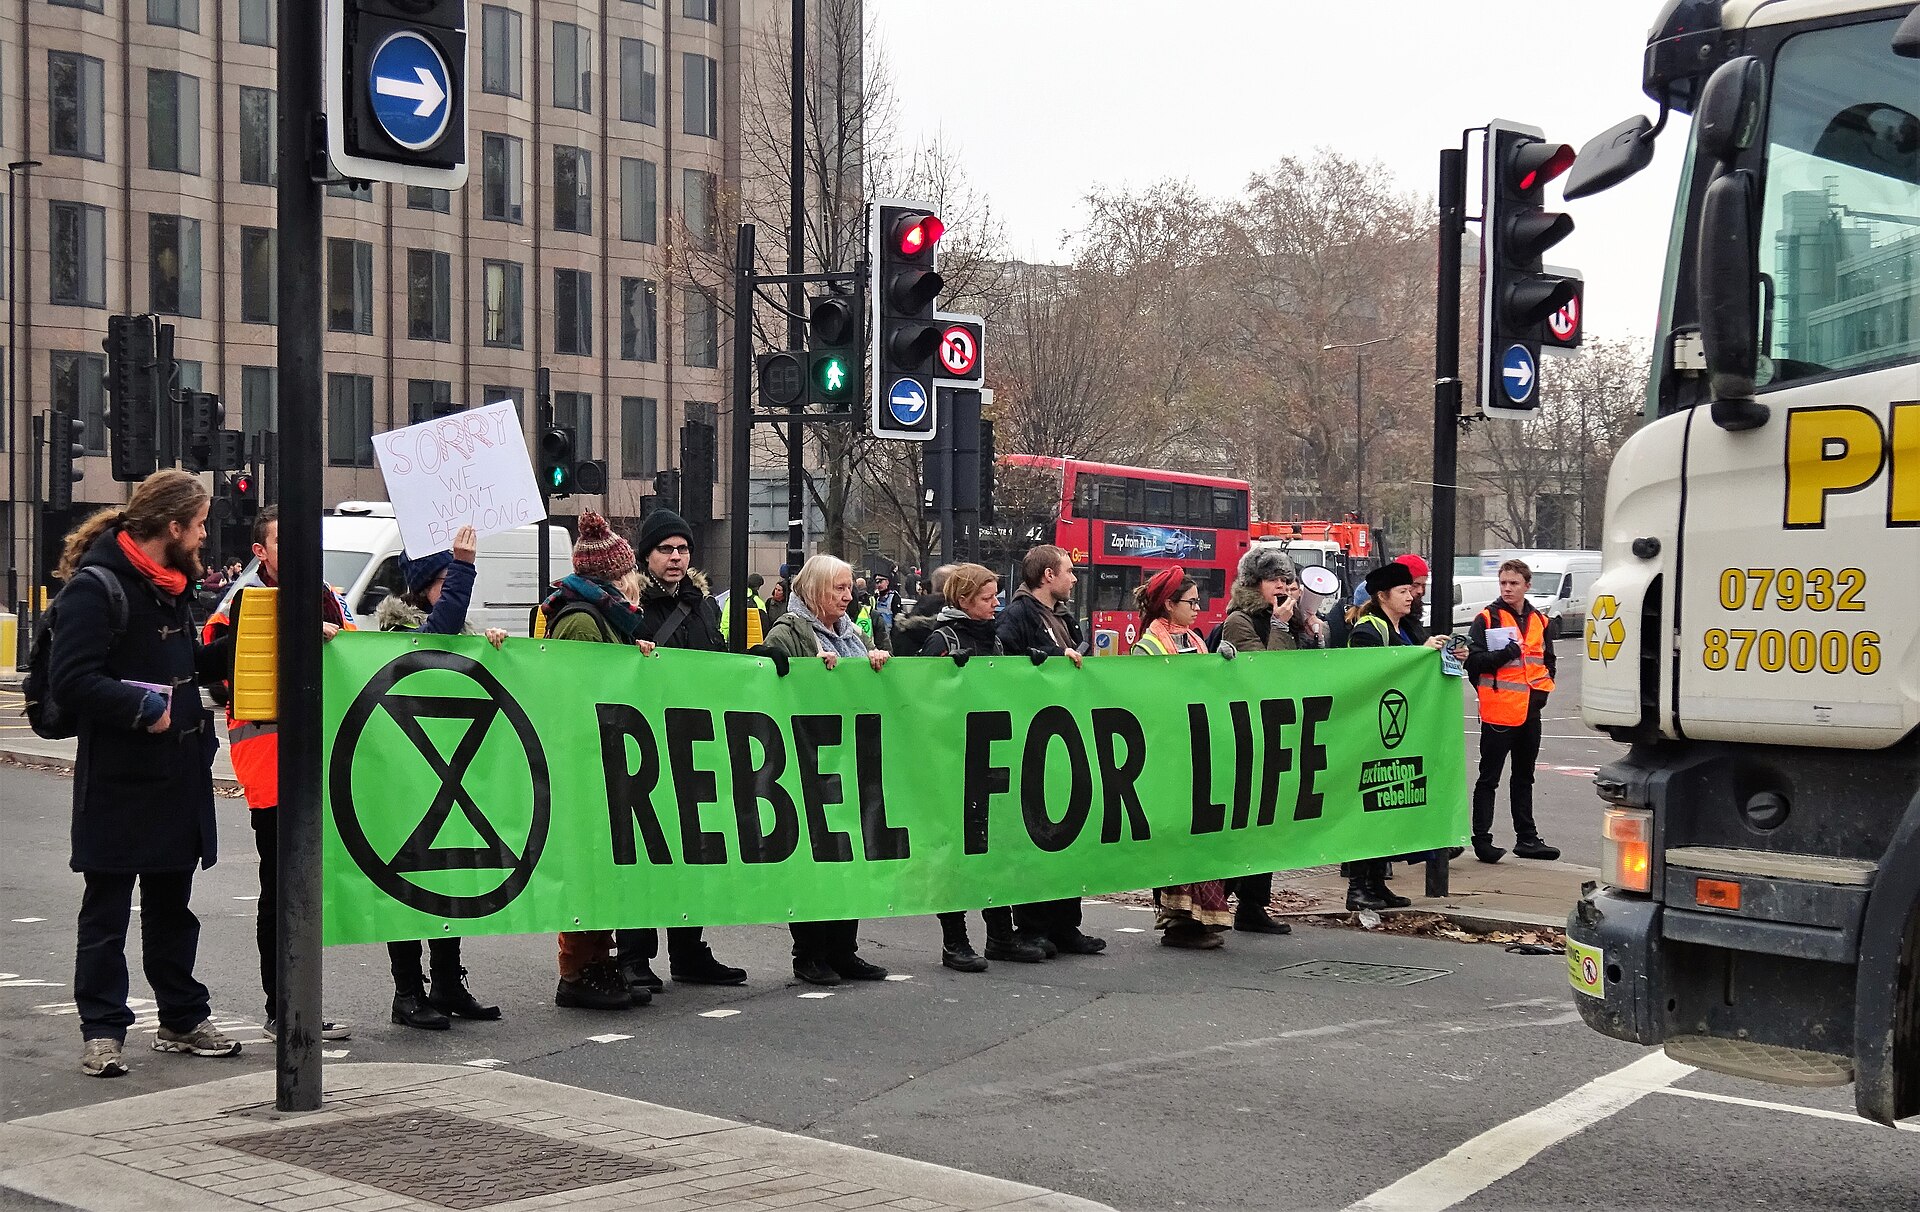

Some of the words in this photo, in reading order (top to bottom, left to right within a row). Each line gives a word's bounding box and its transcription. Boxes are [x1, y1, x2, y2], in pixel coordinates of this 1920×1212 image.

[385, 408, 508, 476] SORRY
[438, 463, 479, 492] WE
[432, 484, 496, 519] WON'T
[1025, 526, 1043, 541] 42
[1111, 533, 1125, 552] Zap
[1125, 533, 1139, 548] from
[1139, 535, 1145, 548] A
[1145, 537, 1152, 548] to
[1719, 567, 1867, 612] 07932
[1702, 628, 1882, 675] 870006
[595, 702, 911, 866] REBEL
[963, 704, 1152, 856] FOR
[1187, 695, 1333, 835] LIFE
[1362, 759, 1416, 785] extinction
[1377, 780, 1425, 808] rebellion
